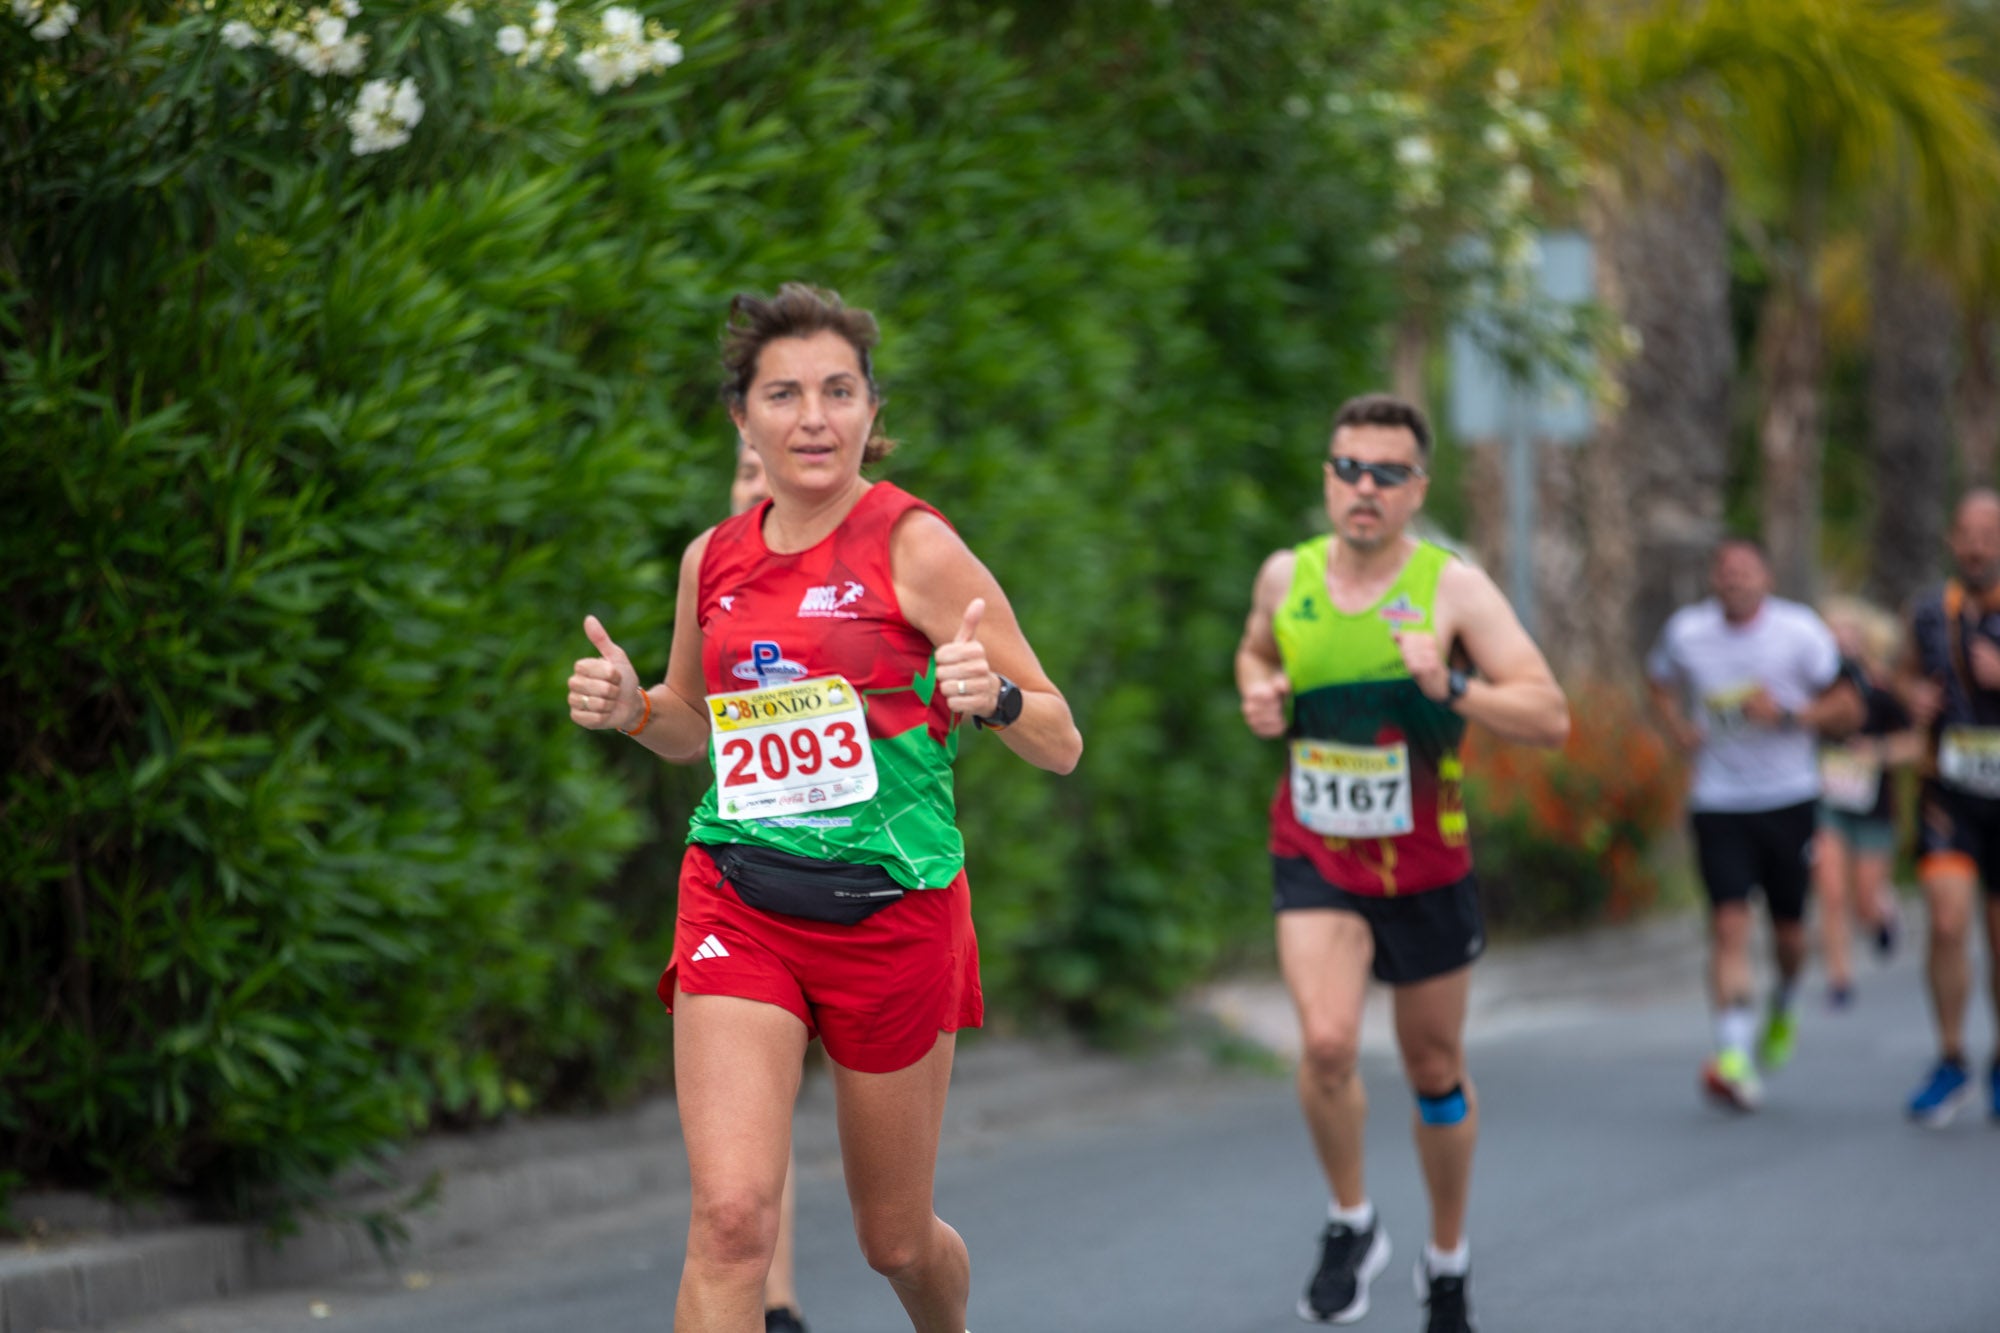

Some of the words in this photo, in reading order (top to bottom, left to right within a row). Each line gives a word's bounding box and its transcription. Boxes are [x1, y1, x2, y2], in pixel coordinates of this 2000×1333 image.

[751, 694, 822, 719] FONDO
[722, 721, 863, 788] 2093
[1302, 774, 1400, 813] 3167
